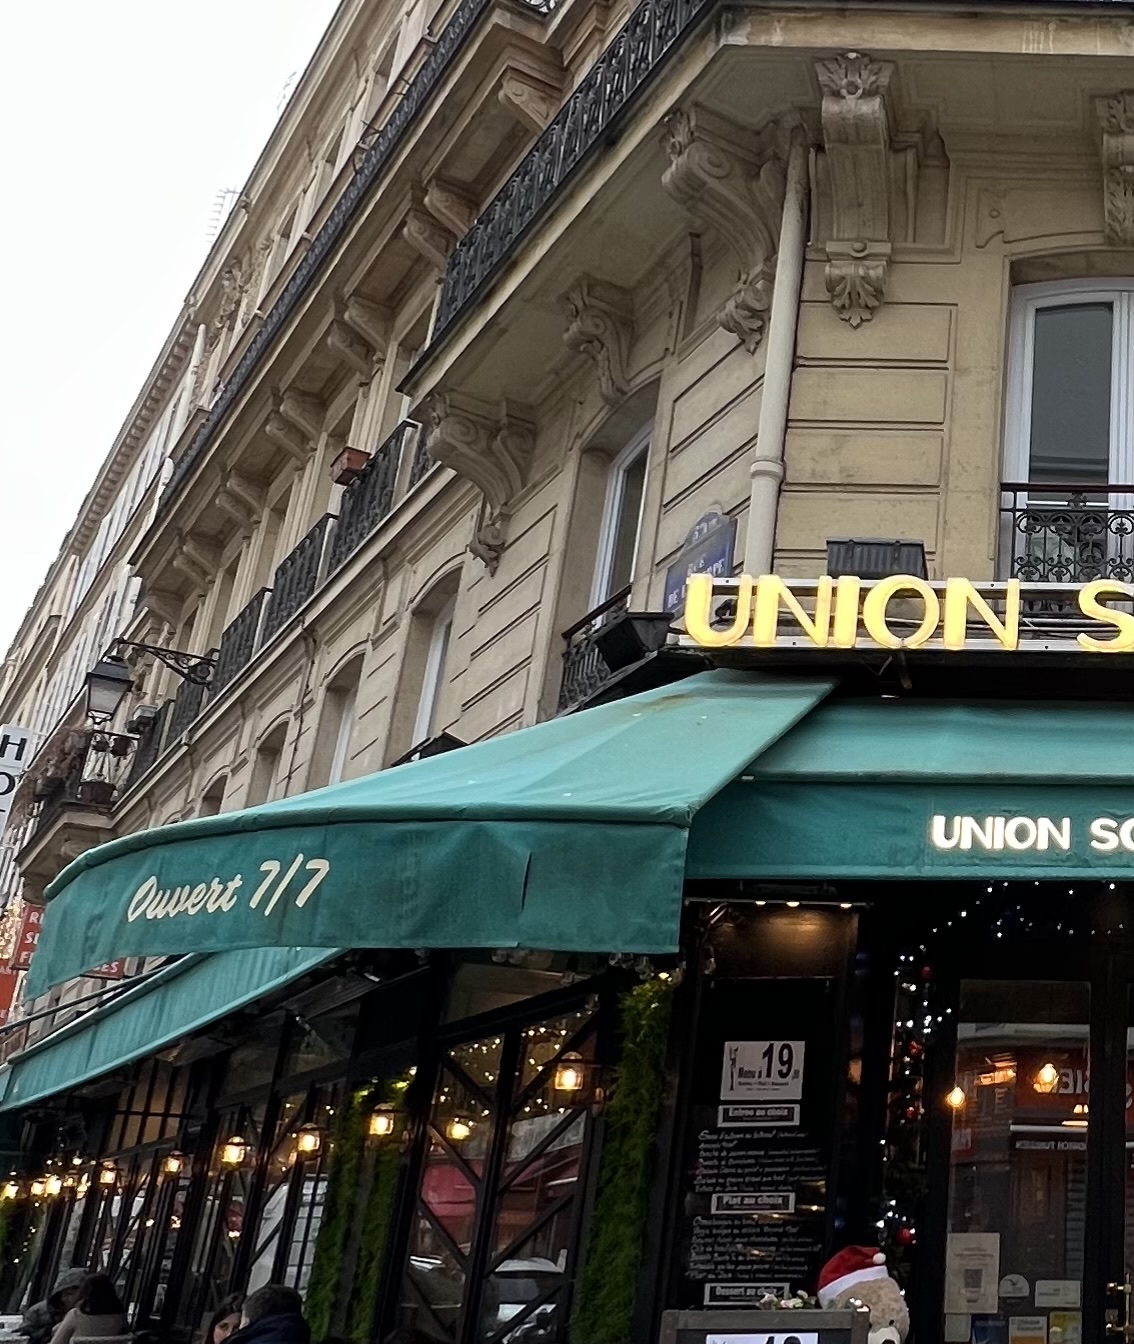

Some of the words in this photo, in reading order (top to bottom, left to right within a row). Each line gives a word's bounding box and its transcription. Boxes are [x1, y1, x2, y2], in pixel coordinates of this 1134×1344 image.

[684, 573, 1020, 650] UNION
[930, 815, 1072, 852] UNION
[127, 873, 243, 923] Ouvert
[250, 853, 330, 917] 7/7
[762, 1043, 794, 1079] 19
